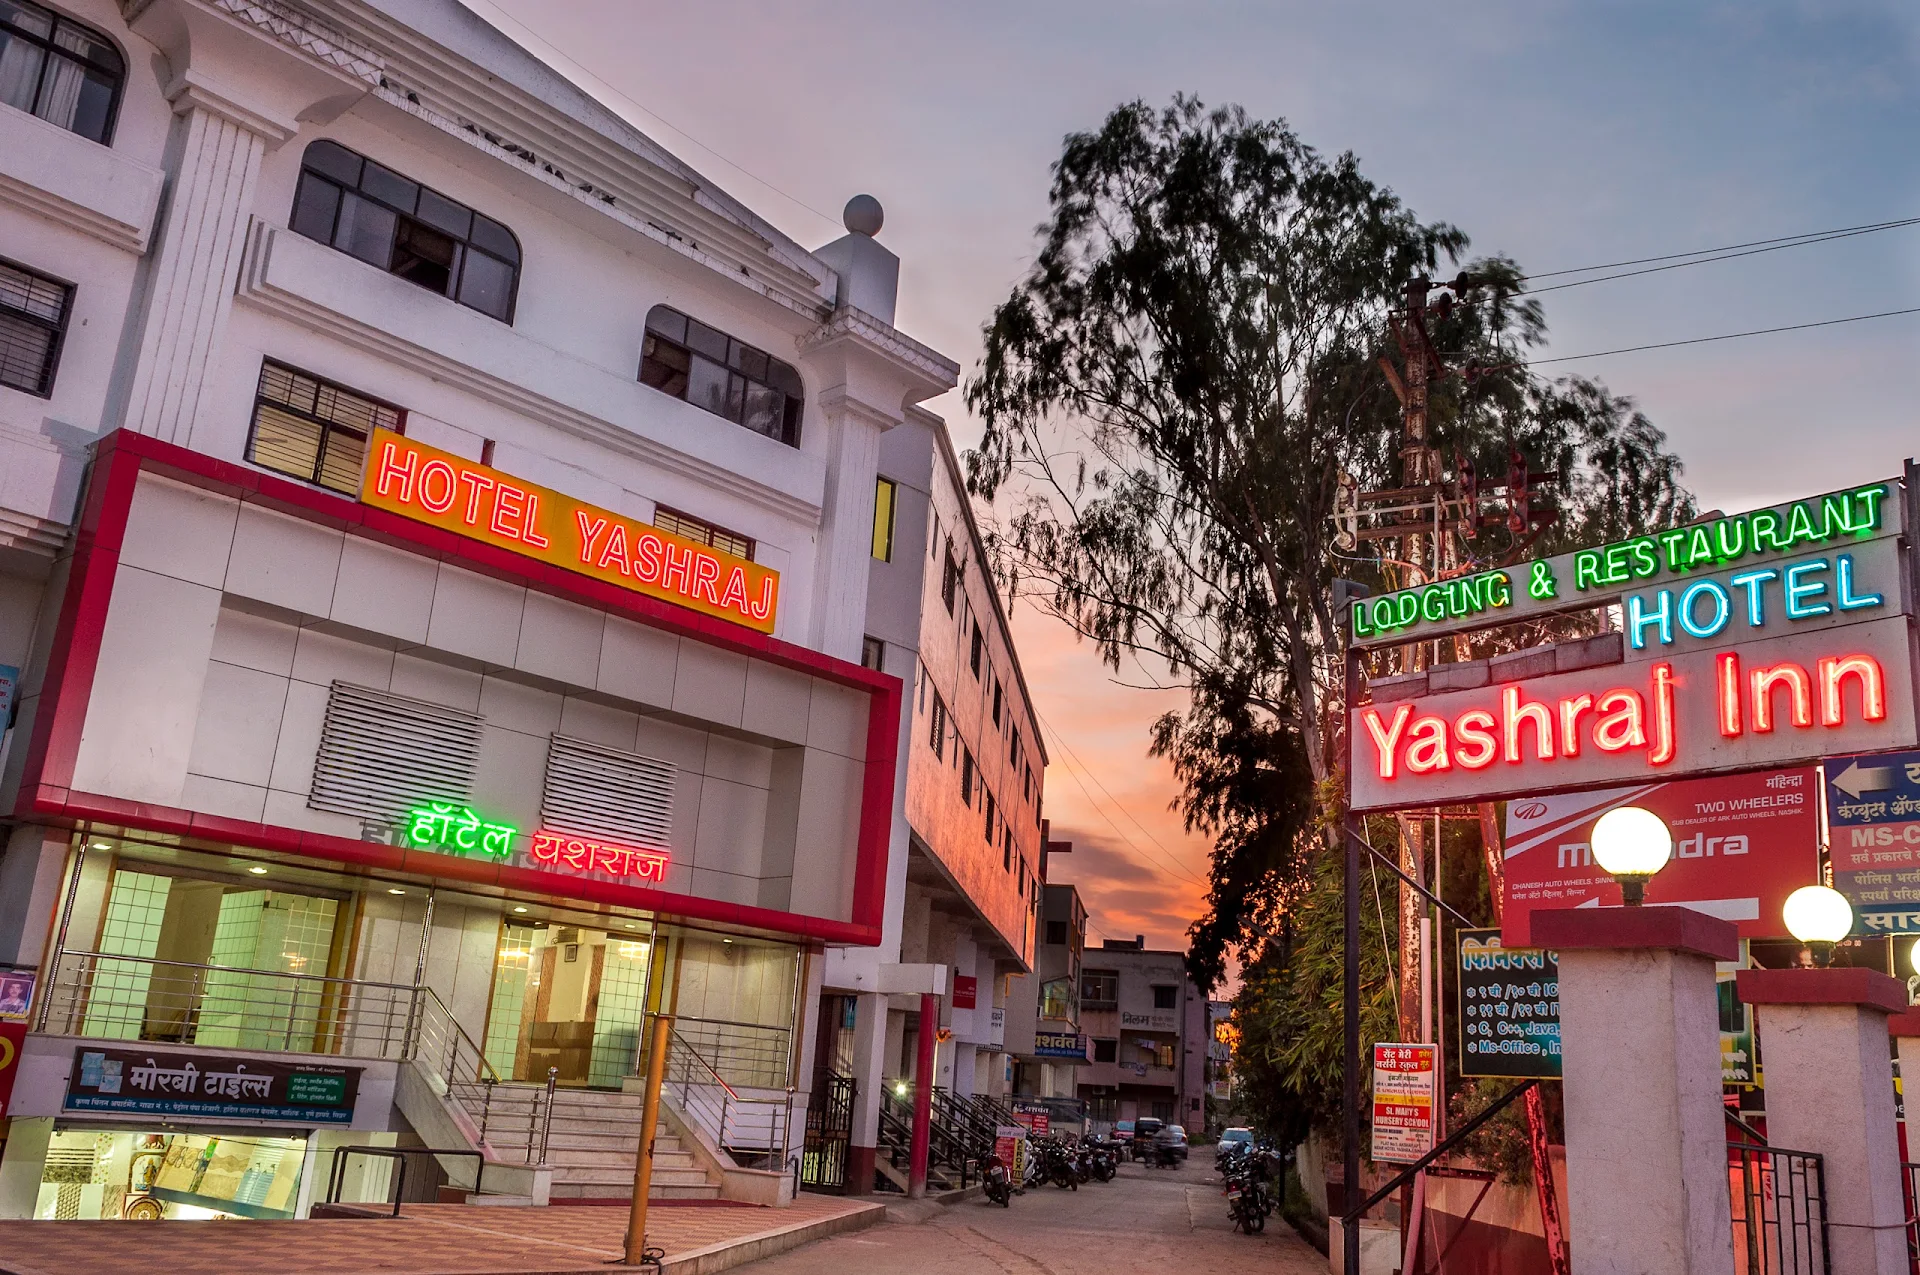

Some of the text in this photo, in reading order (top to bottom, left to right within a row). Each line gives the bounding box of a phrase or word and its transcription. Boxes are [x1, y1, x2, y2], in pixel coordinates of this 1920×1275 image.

[376, 441, 774, 621] HOTEL YASHRAJ
[1354, 484, 1888, 637] LODGING & RESTAURANT
[1628, 554, 1884, 649] HOTEL
[1361, 651, 1886, 780] Yashraj Inn
[1695, 793, 1804, 814] TWO WHEELERS
[1685, 816, 1708, 825] DEALER
[1717, 814, 1731, 822] ARK
[409, 801, 518, 857] हॉटेल
[534, 834, 669, 882] यशराज
[1851, 850, 1870, 864] सर्व
[1872, 847, 1912, 863] प्रकारचे
[1512, 882, 1543, 890] DHANESH
[1545, 880, 1562, 888] AUTO
[1854, 870, 1892, 885] पोलिस
[1860, 888, 1888, 902] स्पर्धा
[1478, 1021, 1493, 1037] C,
[1497, 1021, 1524, 1037] C++,
[130, 1058, 274, 1099] मोरबी टाईल्स
[1375, 1116, 1403, 1126] NURSERY
